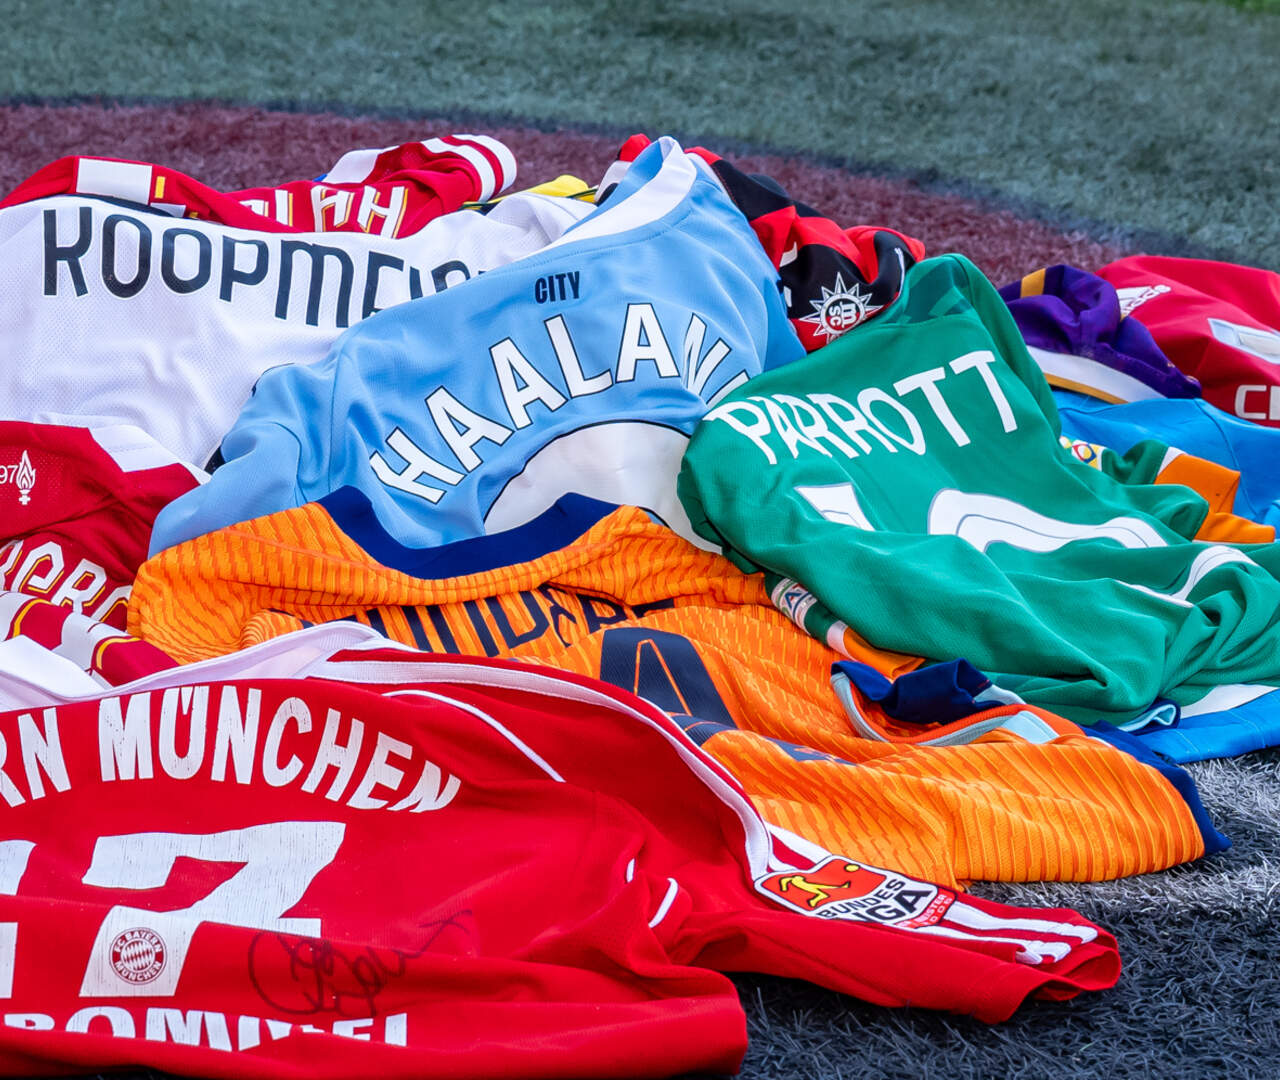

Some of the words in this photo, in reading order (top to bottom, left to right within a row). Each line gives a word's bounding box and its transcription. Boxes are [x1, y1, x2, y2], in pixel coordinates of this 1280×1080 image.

[534, 271, 581, 304] CITY
[703, 350, 1019, 465] PARROTT
[98, 684, 462, 814] MÜNCHEN
[816, 878, 906, 918] BUNDES
[853, 889, 933, 921] IGA
[114, 939, 125, 952] FC
[125, 931, 162, 952] BAYERN
